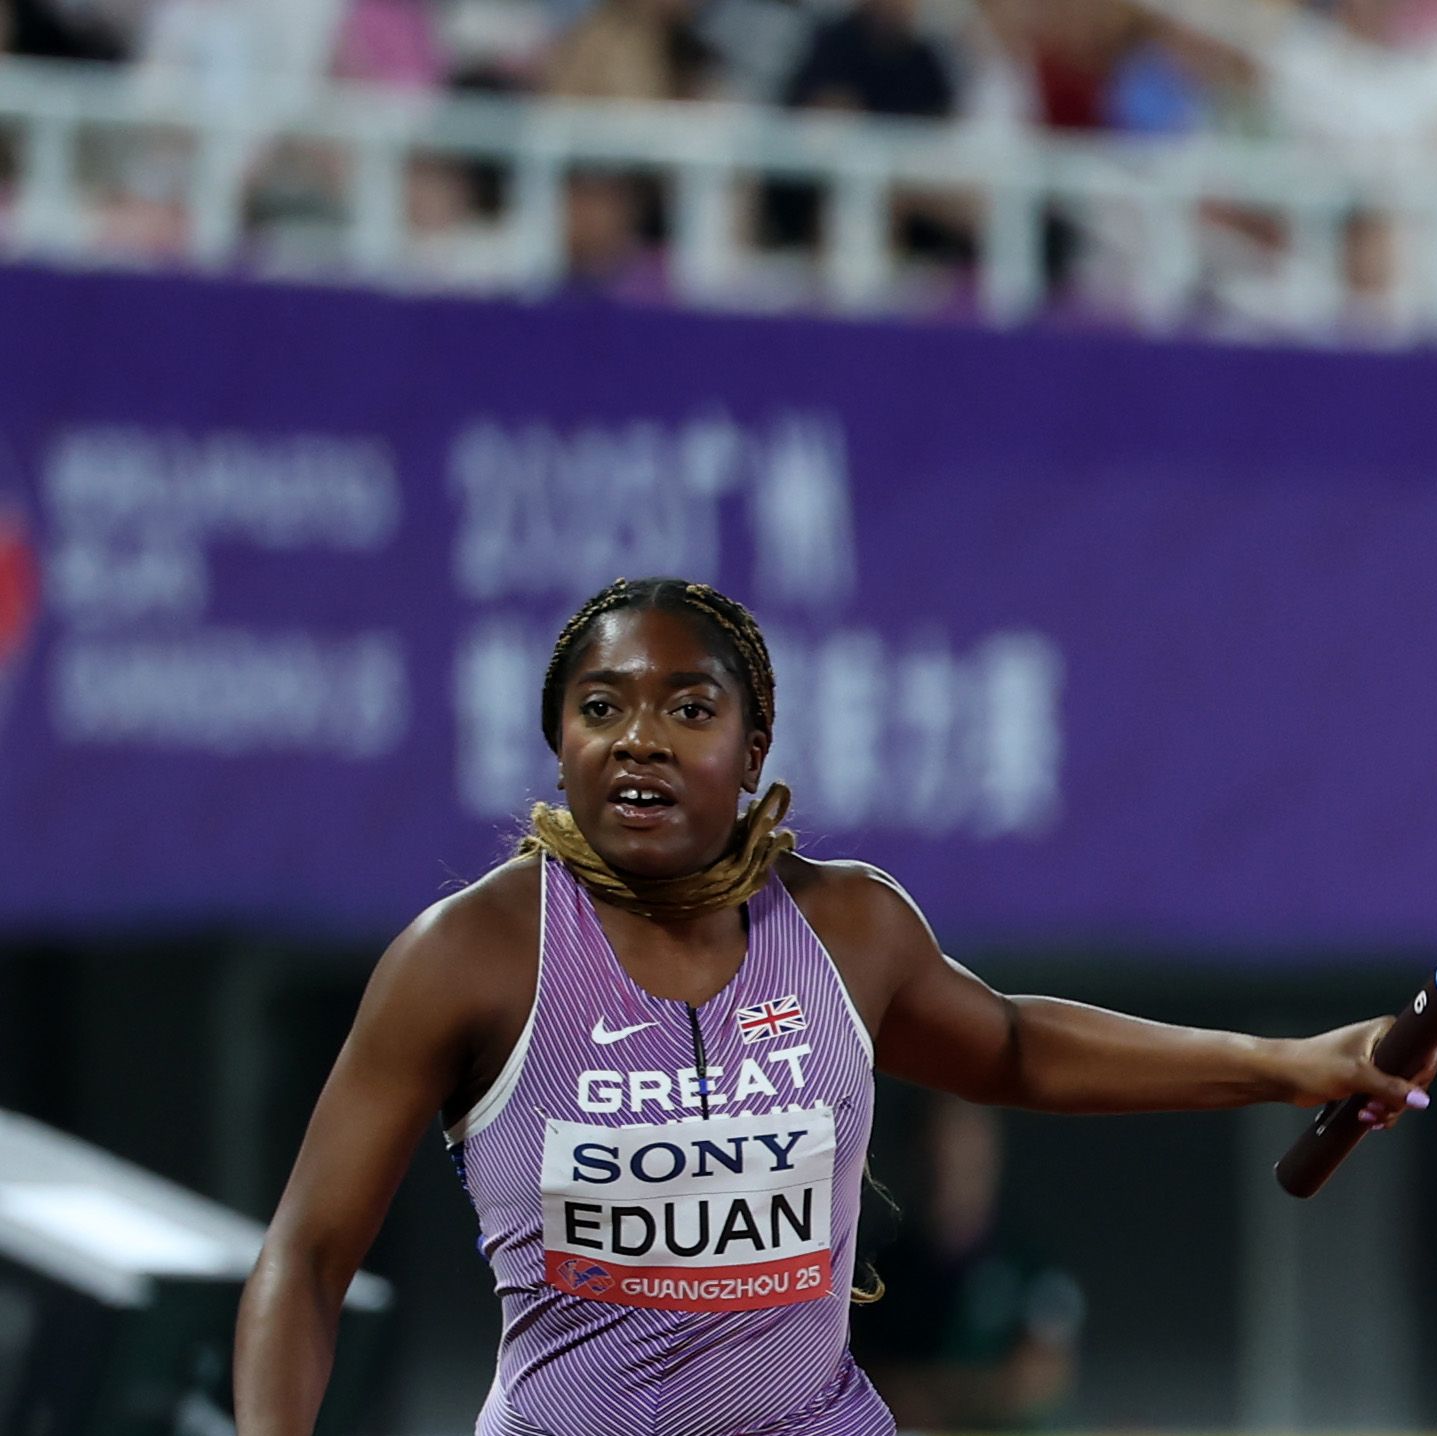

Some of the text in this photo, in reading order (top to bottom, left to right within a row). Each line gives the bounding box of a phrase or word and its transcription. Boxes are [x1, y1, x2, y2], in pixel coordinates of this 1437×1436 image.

[577, 1042, 812, 1114] GREAT
[572, 1130, 809, 1184] SONY
[564, 1187, 814, 1258] EDUAN
[620, 1264, 822, 1301] GUANGZHOU 25
